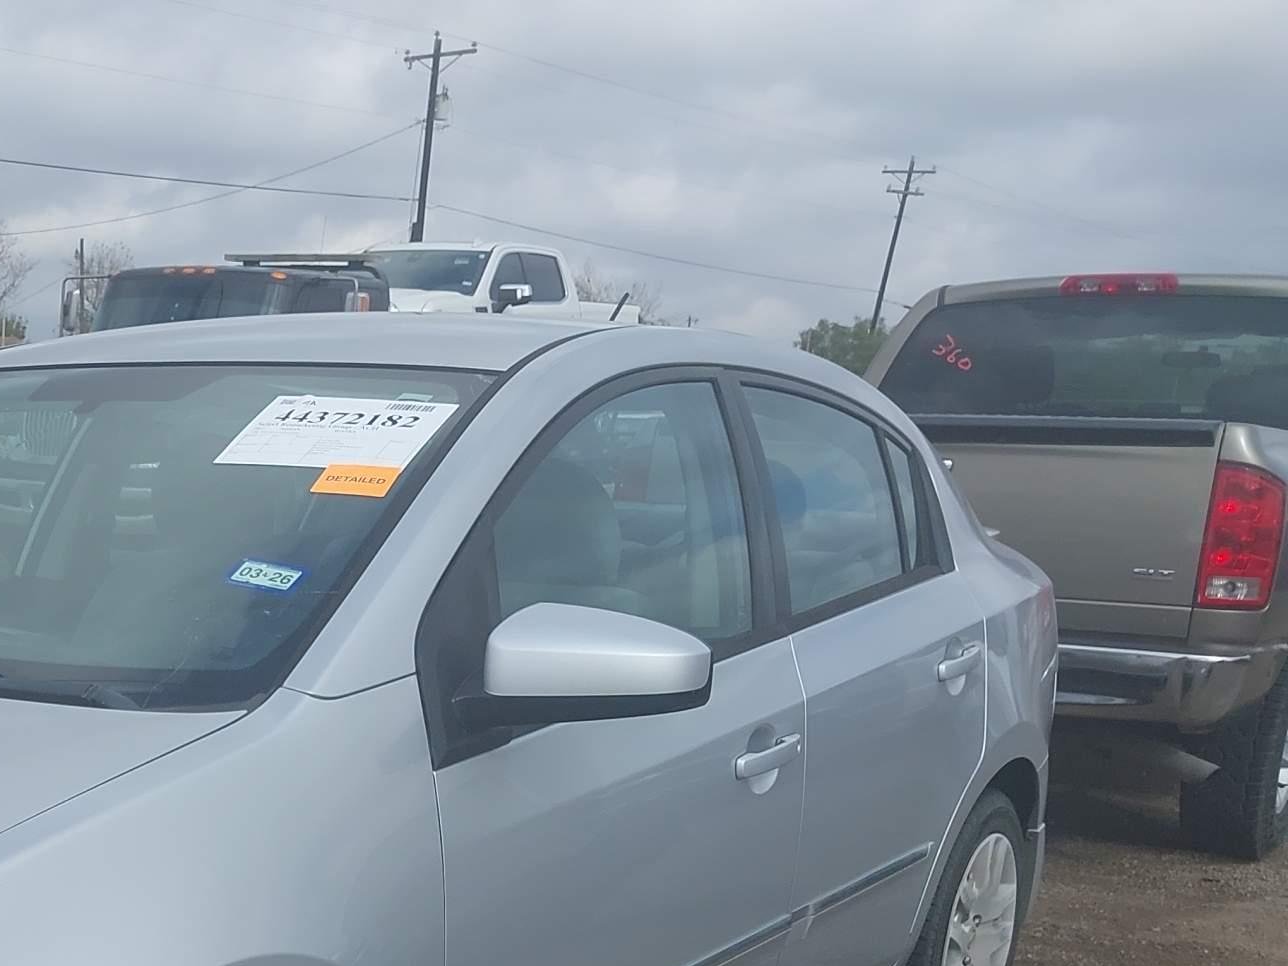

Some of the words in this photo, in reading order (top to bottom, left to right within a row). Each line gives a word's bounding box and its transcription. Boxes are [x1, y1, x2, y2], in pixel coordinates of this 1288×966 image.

[932, 334, 972, 370] 360
[275, 409, 420, 428] 44372182
[325, 474, 387, 485] DETAILED
